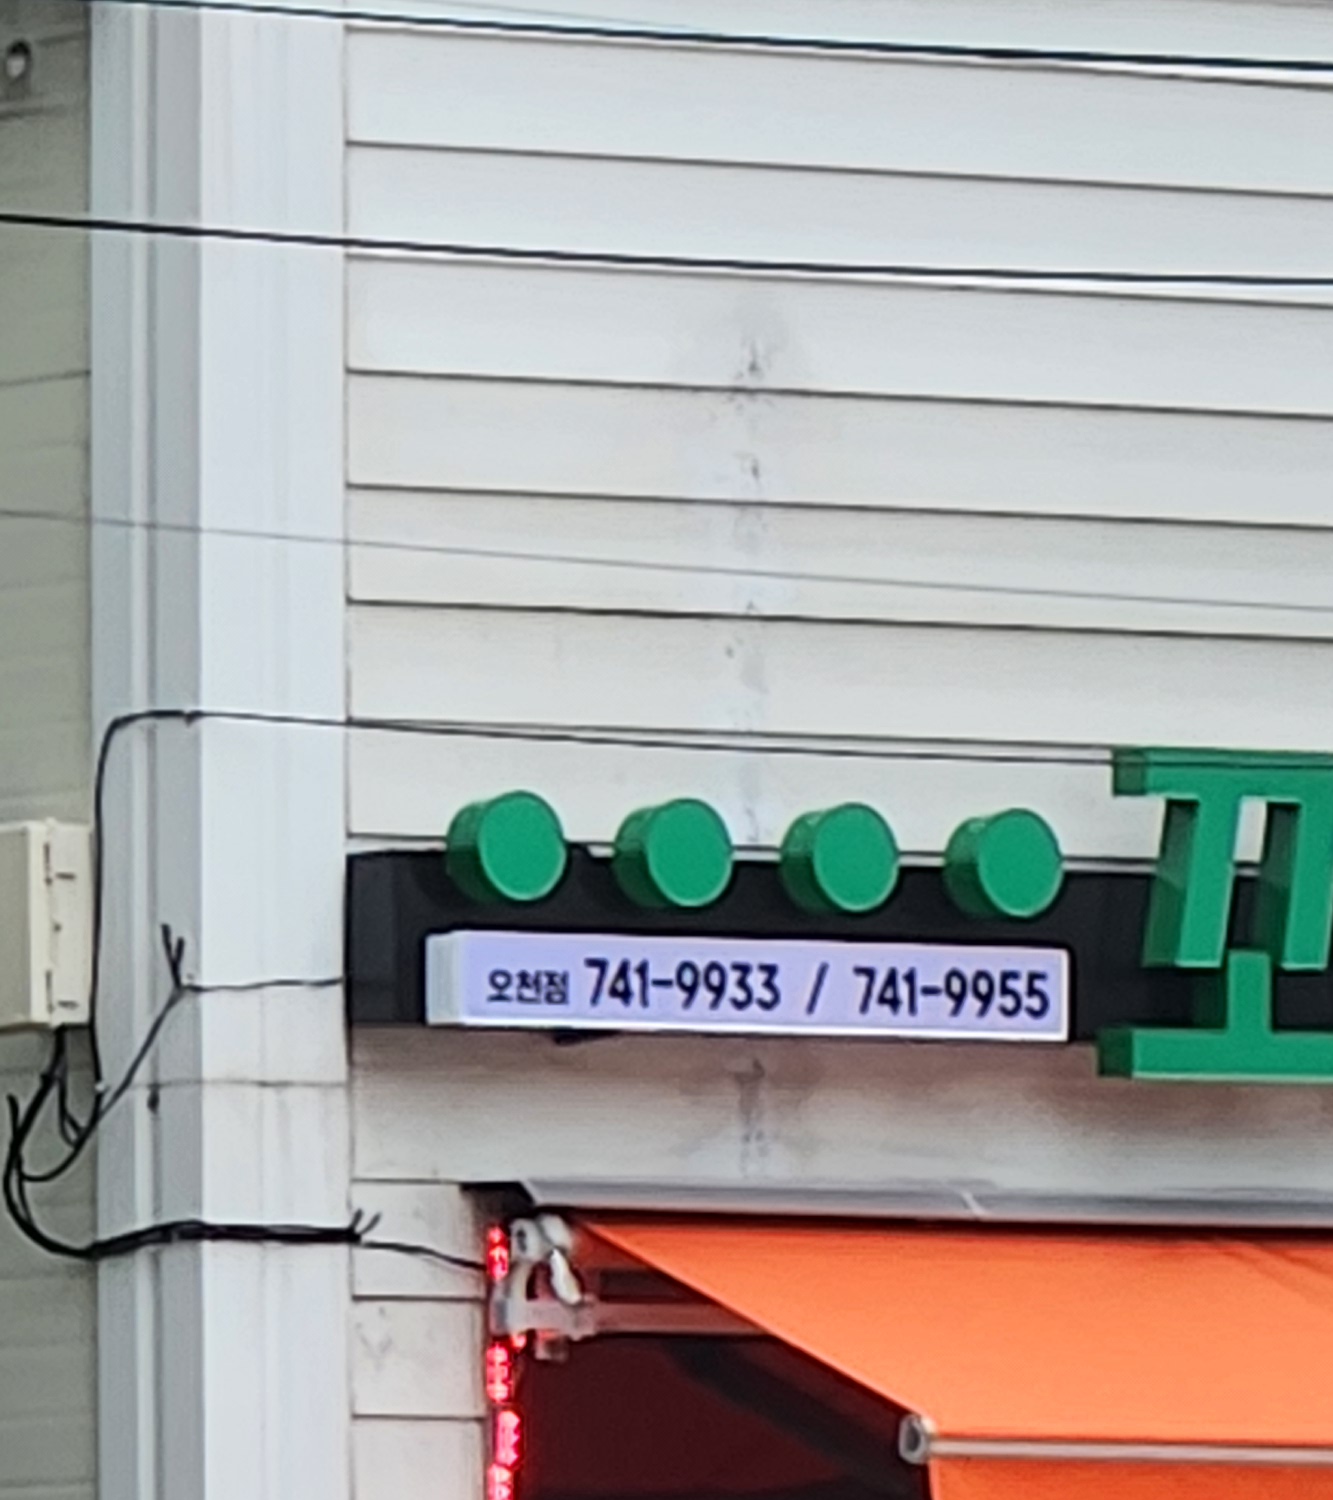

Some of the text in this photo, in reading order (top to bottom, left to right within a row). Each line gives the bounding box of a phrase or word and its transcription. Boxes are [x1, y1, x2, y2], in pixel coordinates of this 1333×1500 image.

[486, 957, 1050, 1018] 오천점 741-9933 / 741-9955
